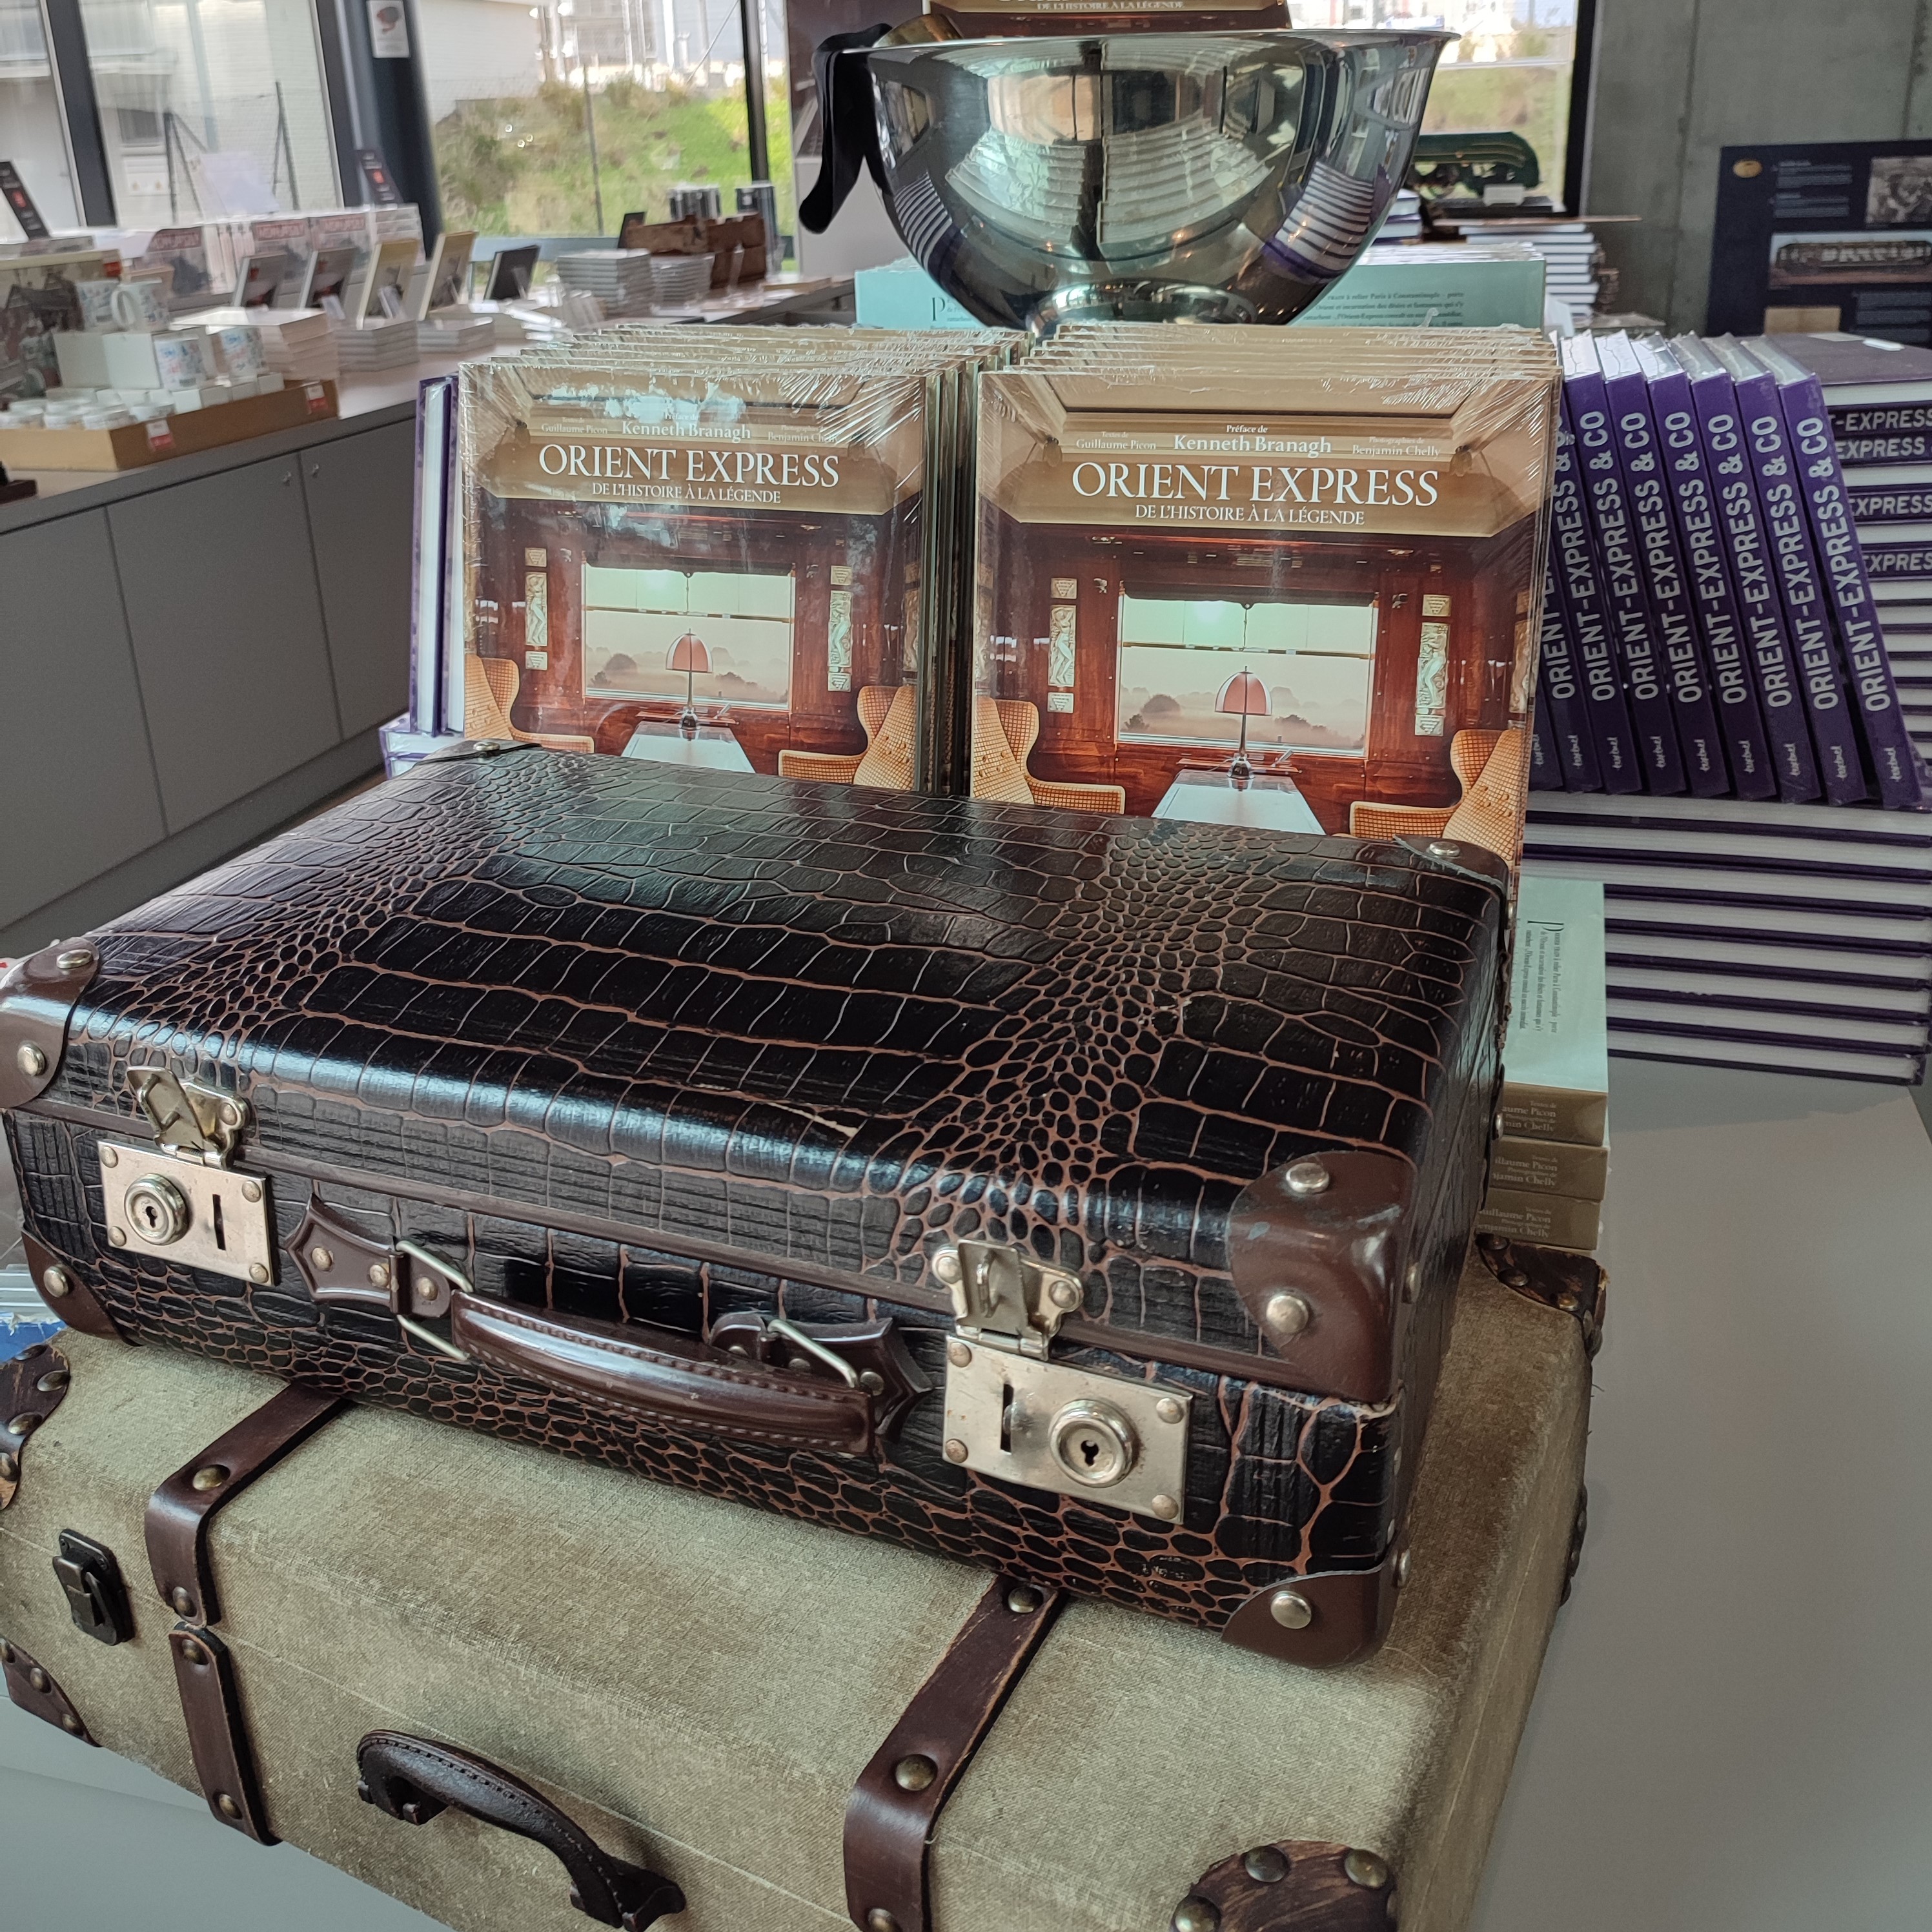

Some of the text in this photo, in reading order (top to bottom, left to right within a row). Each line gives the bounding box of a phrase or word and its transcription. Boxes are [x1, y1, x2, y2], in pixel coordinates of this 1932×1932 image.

[541, 423, 608, 434] Guillaume Picon
[622, 421, 751, 443] Kenneth Branagh
[768, 431, 809, 443] Benjamin
[1076, 438, 1157, 451] Guillaume Picon
[1226, 425, 1268, 434] Préface de
[1174, 434, 1332, 458] Kenneth Branagh
[1352, 445, 1440, 460] Benjamin Chelly
[538, 443, 839, 488] ORIENT EXPRESS
[593, 482, 781, 503] DE L'HISTOIRE À LA LÉGENDE
[1072, 462, 1438, 507] ORIENT EXPRESS
[1135, 503, 1365, 525] DE L'HISTOIRE À LA LÉGENDE
[1580, 411, 1658, 701] ORIENT-EXPRESS & CO
[1620, 412, 1702, 703] ORIENT-EXPRESS & CO
[1665, 411, 1747, 704] ORIENT-EXPRESS & CO
[1707, 414, 1792, 708] ORIENT-EXPRESS & CO
[1751, 416, 1838, 710] ORIENT-EXPRESS & CO
[1796, 418, 1891, 712] ORIENT-EXPRESS & CO
[1552, 480, 1614, 702] ORIENT-EXPRESS
